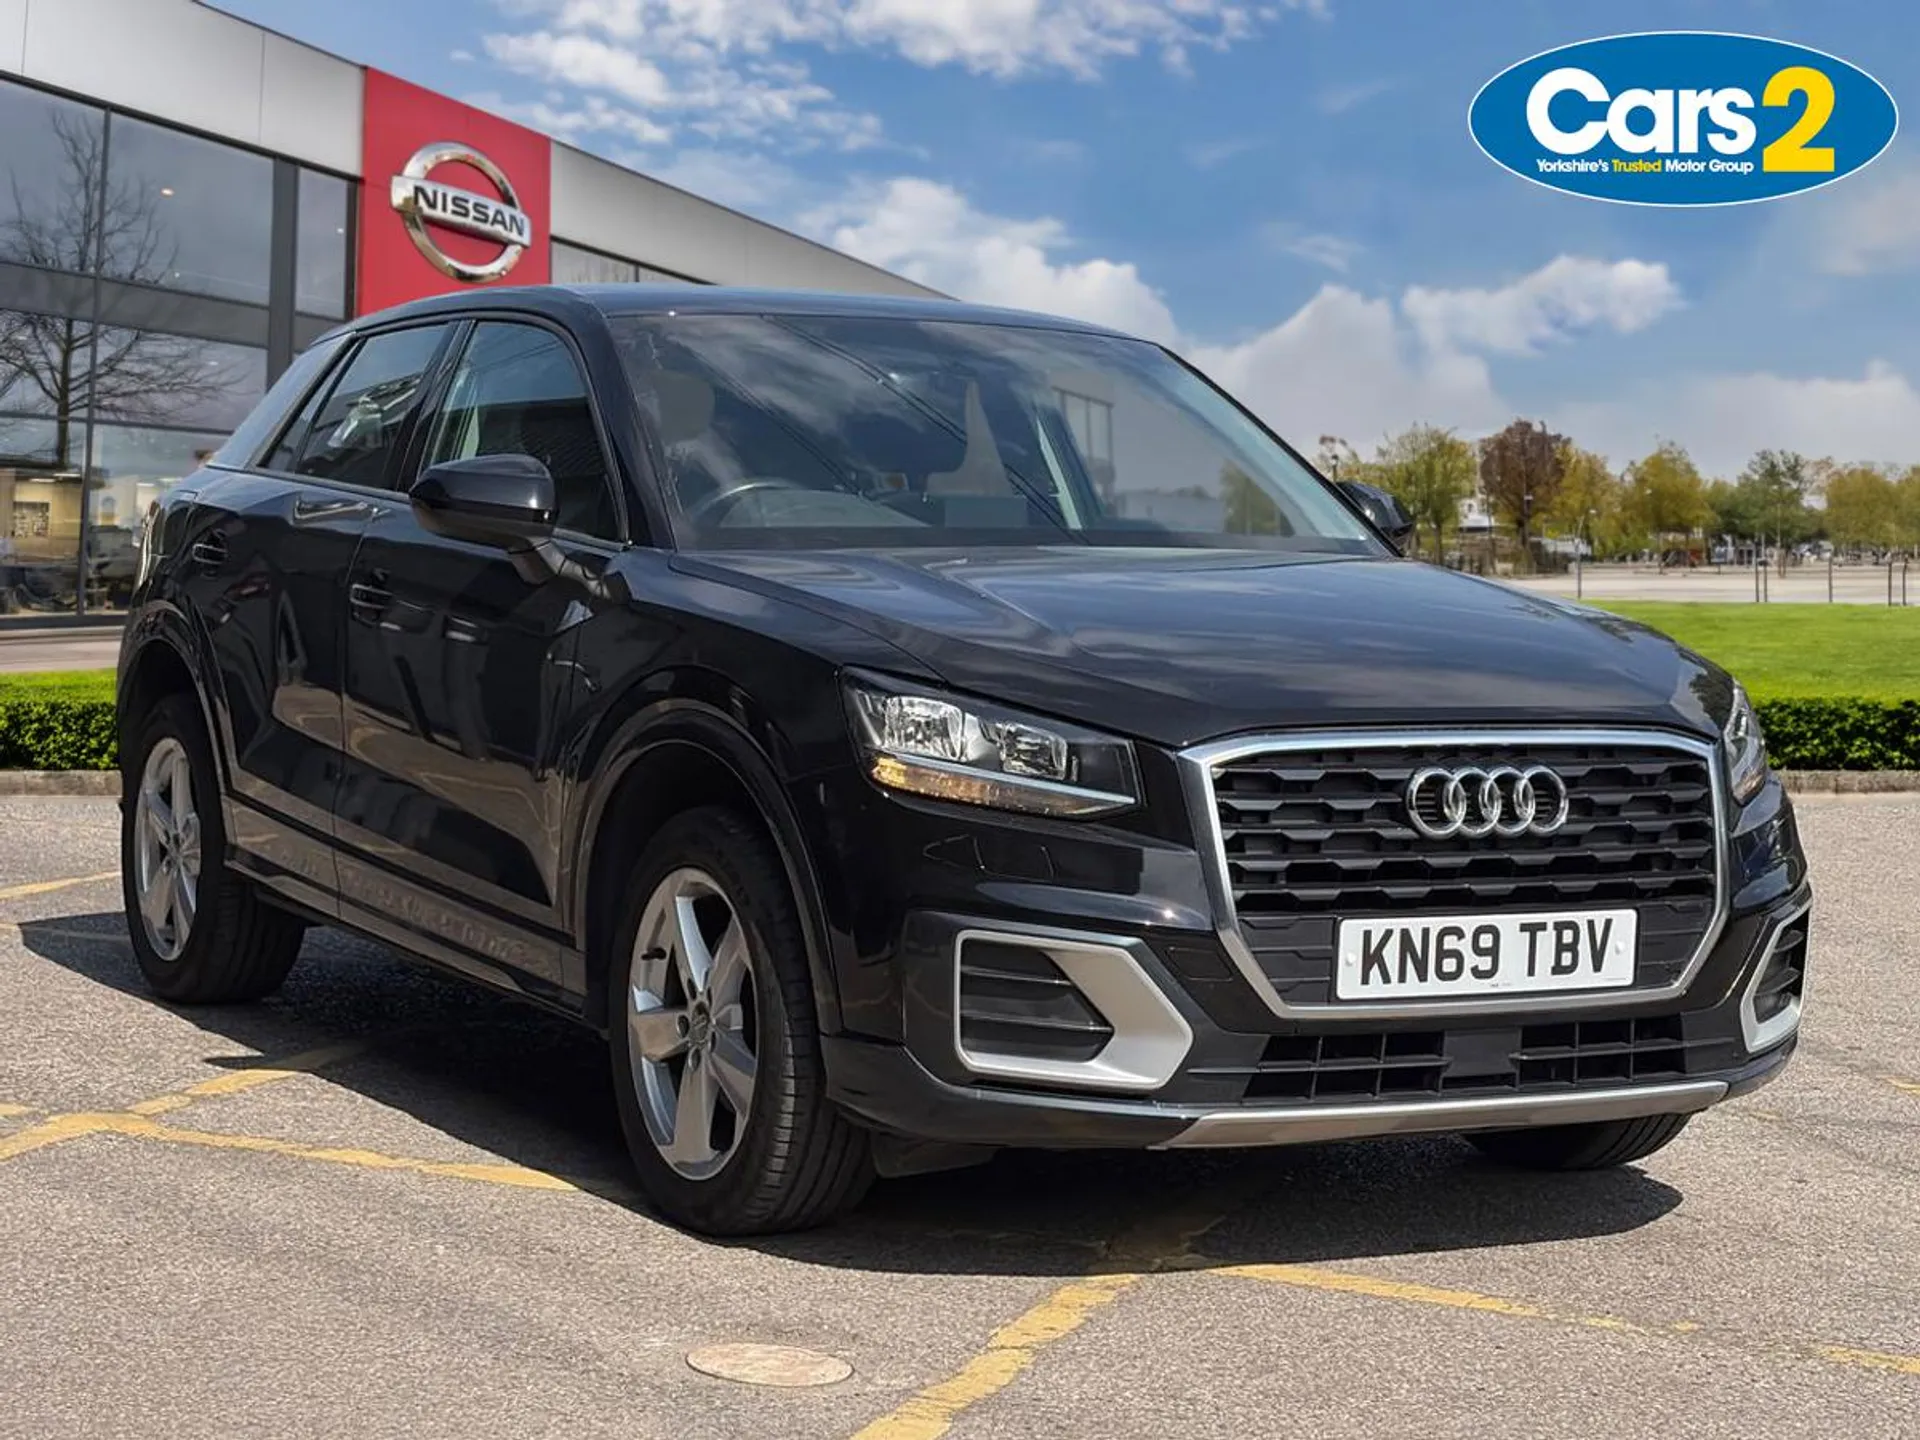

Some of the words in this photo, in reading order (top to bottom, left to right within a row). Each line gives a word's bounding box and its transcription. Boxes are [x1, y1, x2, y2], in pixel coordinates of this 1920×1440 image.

[413, 185, 525, 236] NISSAN
[1360, 924, 1501, 985] KN69
[1519, 918, 1614, 977] TBV
